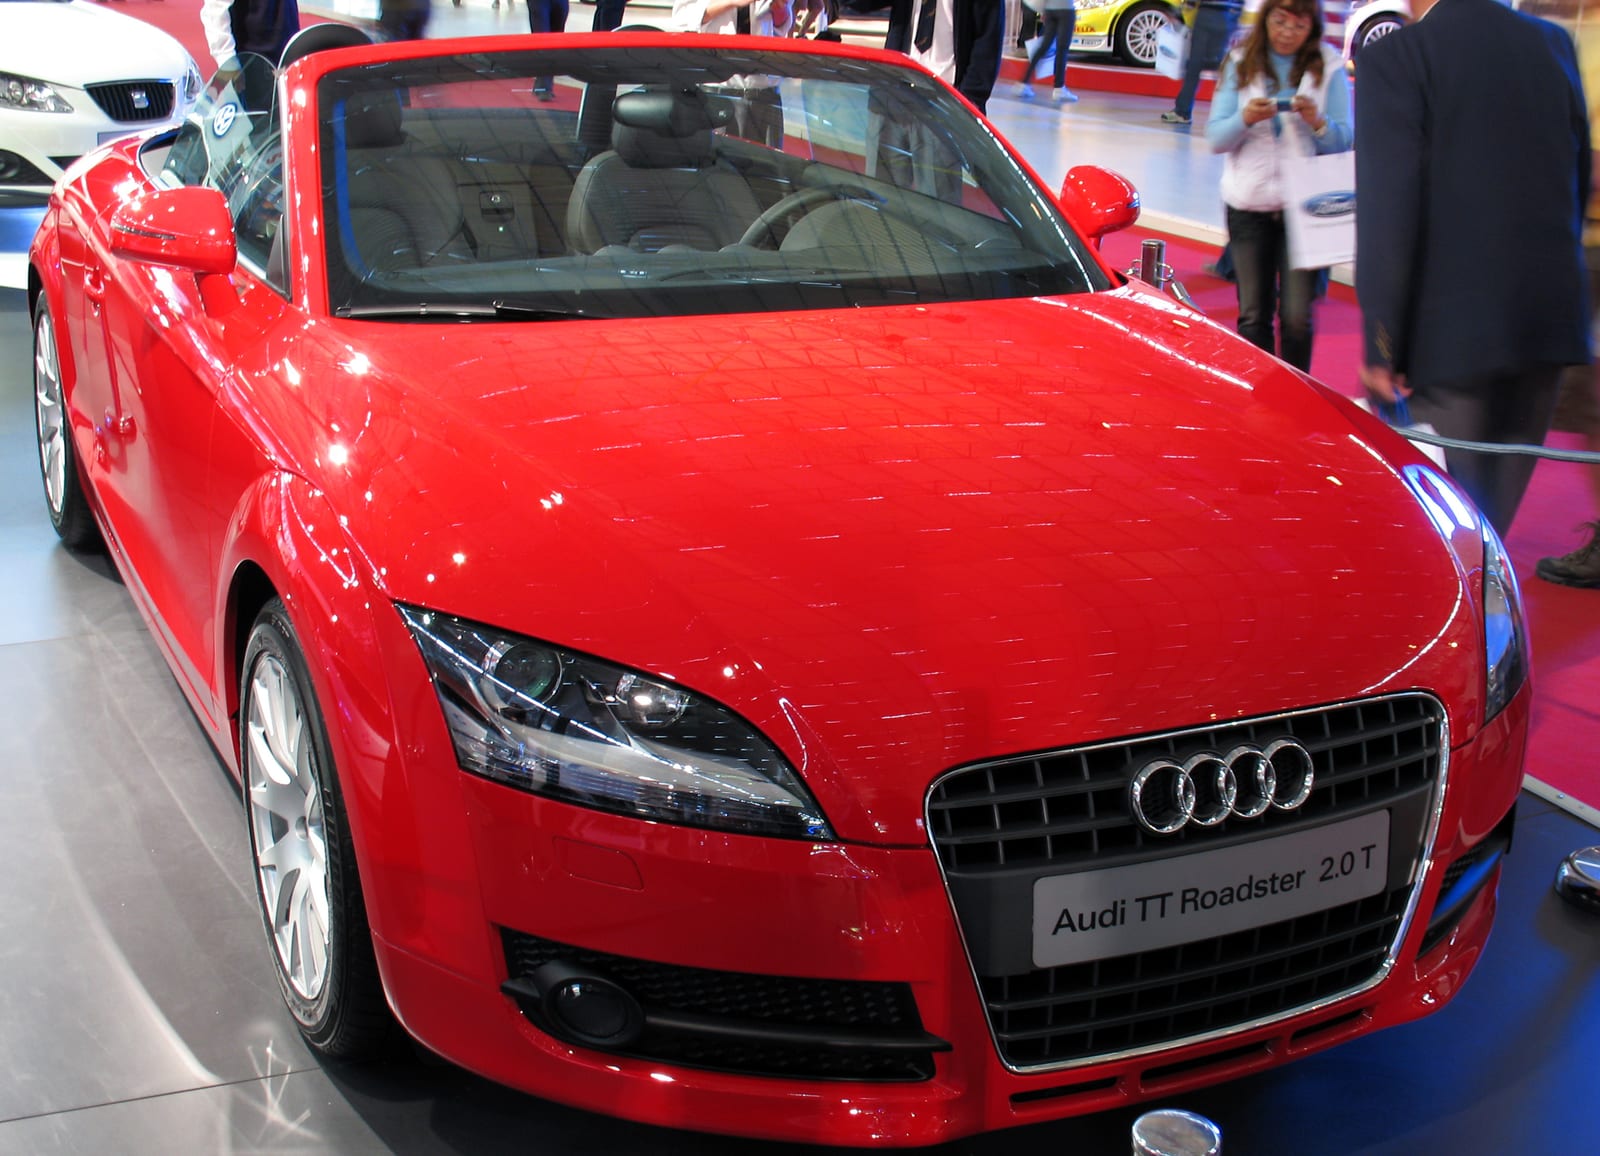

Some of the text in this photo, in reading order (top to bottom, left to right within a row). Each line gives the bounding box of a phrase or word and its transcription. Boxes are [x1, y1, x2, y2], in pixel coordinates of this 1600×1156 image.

[1052, 843, 1377, 936] Audi TT Roadster 2.0 T
